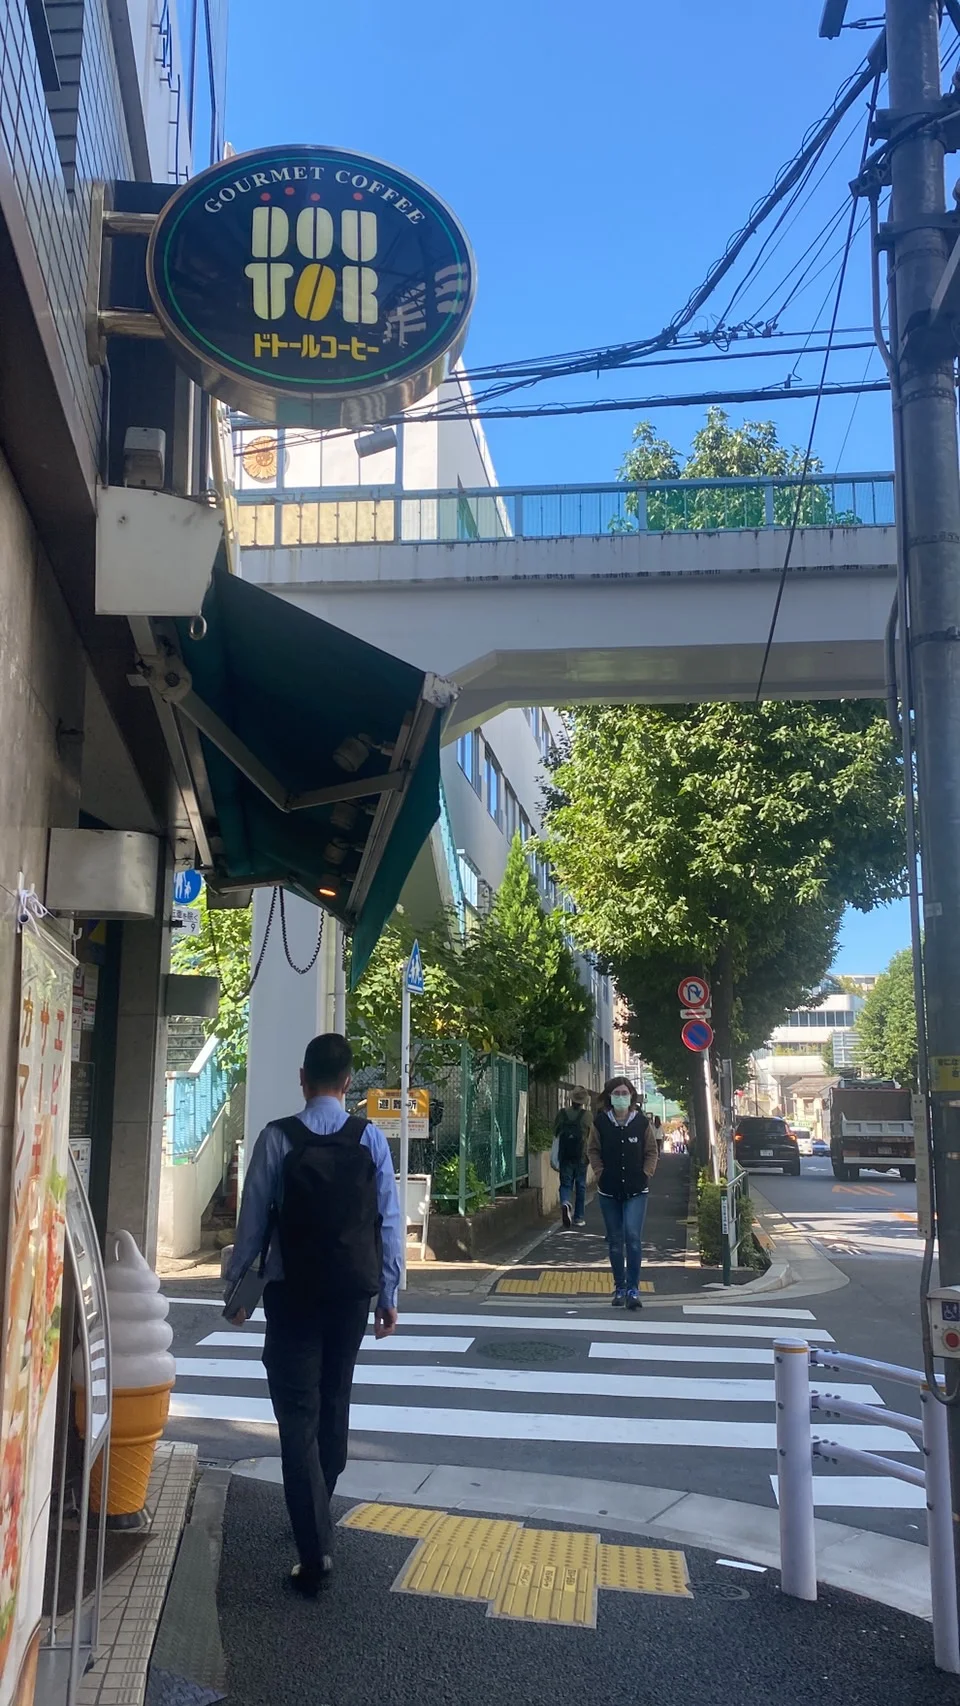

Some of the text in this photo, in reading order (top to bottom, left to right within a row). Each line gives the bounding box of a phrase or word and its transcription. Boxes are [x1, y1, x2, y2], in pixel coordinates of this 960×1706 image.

[204, 166, 426, 225] GOURMET COFFEE
[254, 333, 380, 361] ドトールコーヒー
[50, 1008, 65, 1116] エビ
